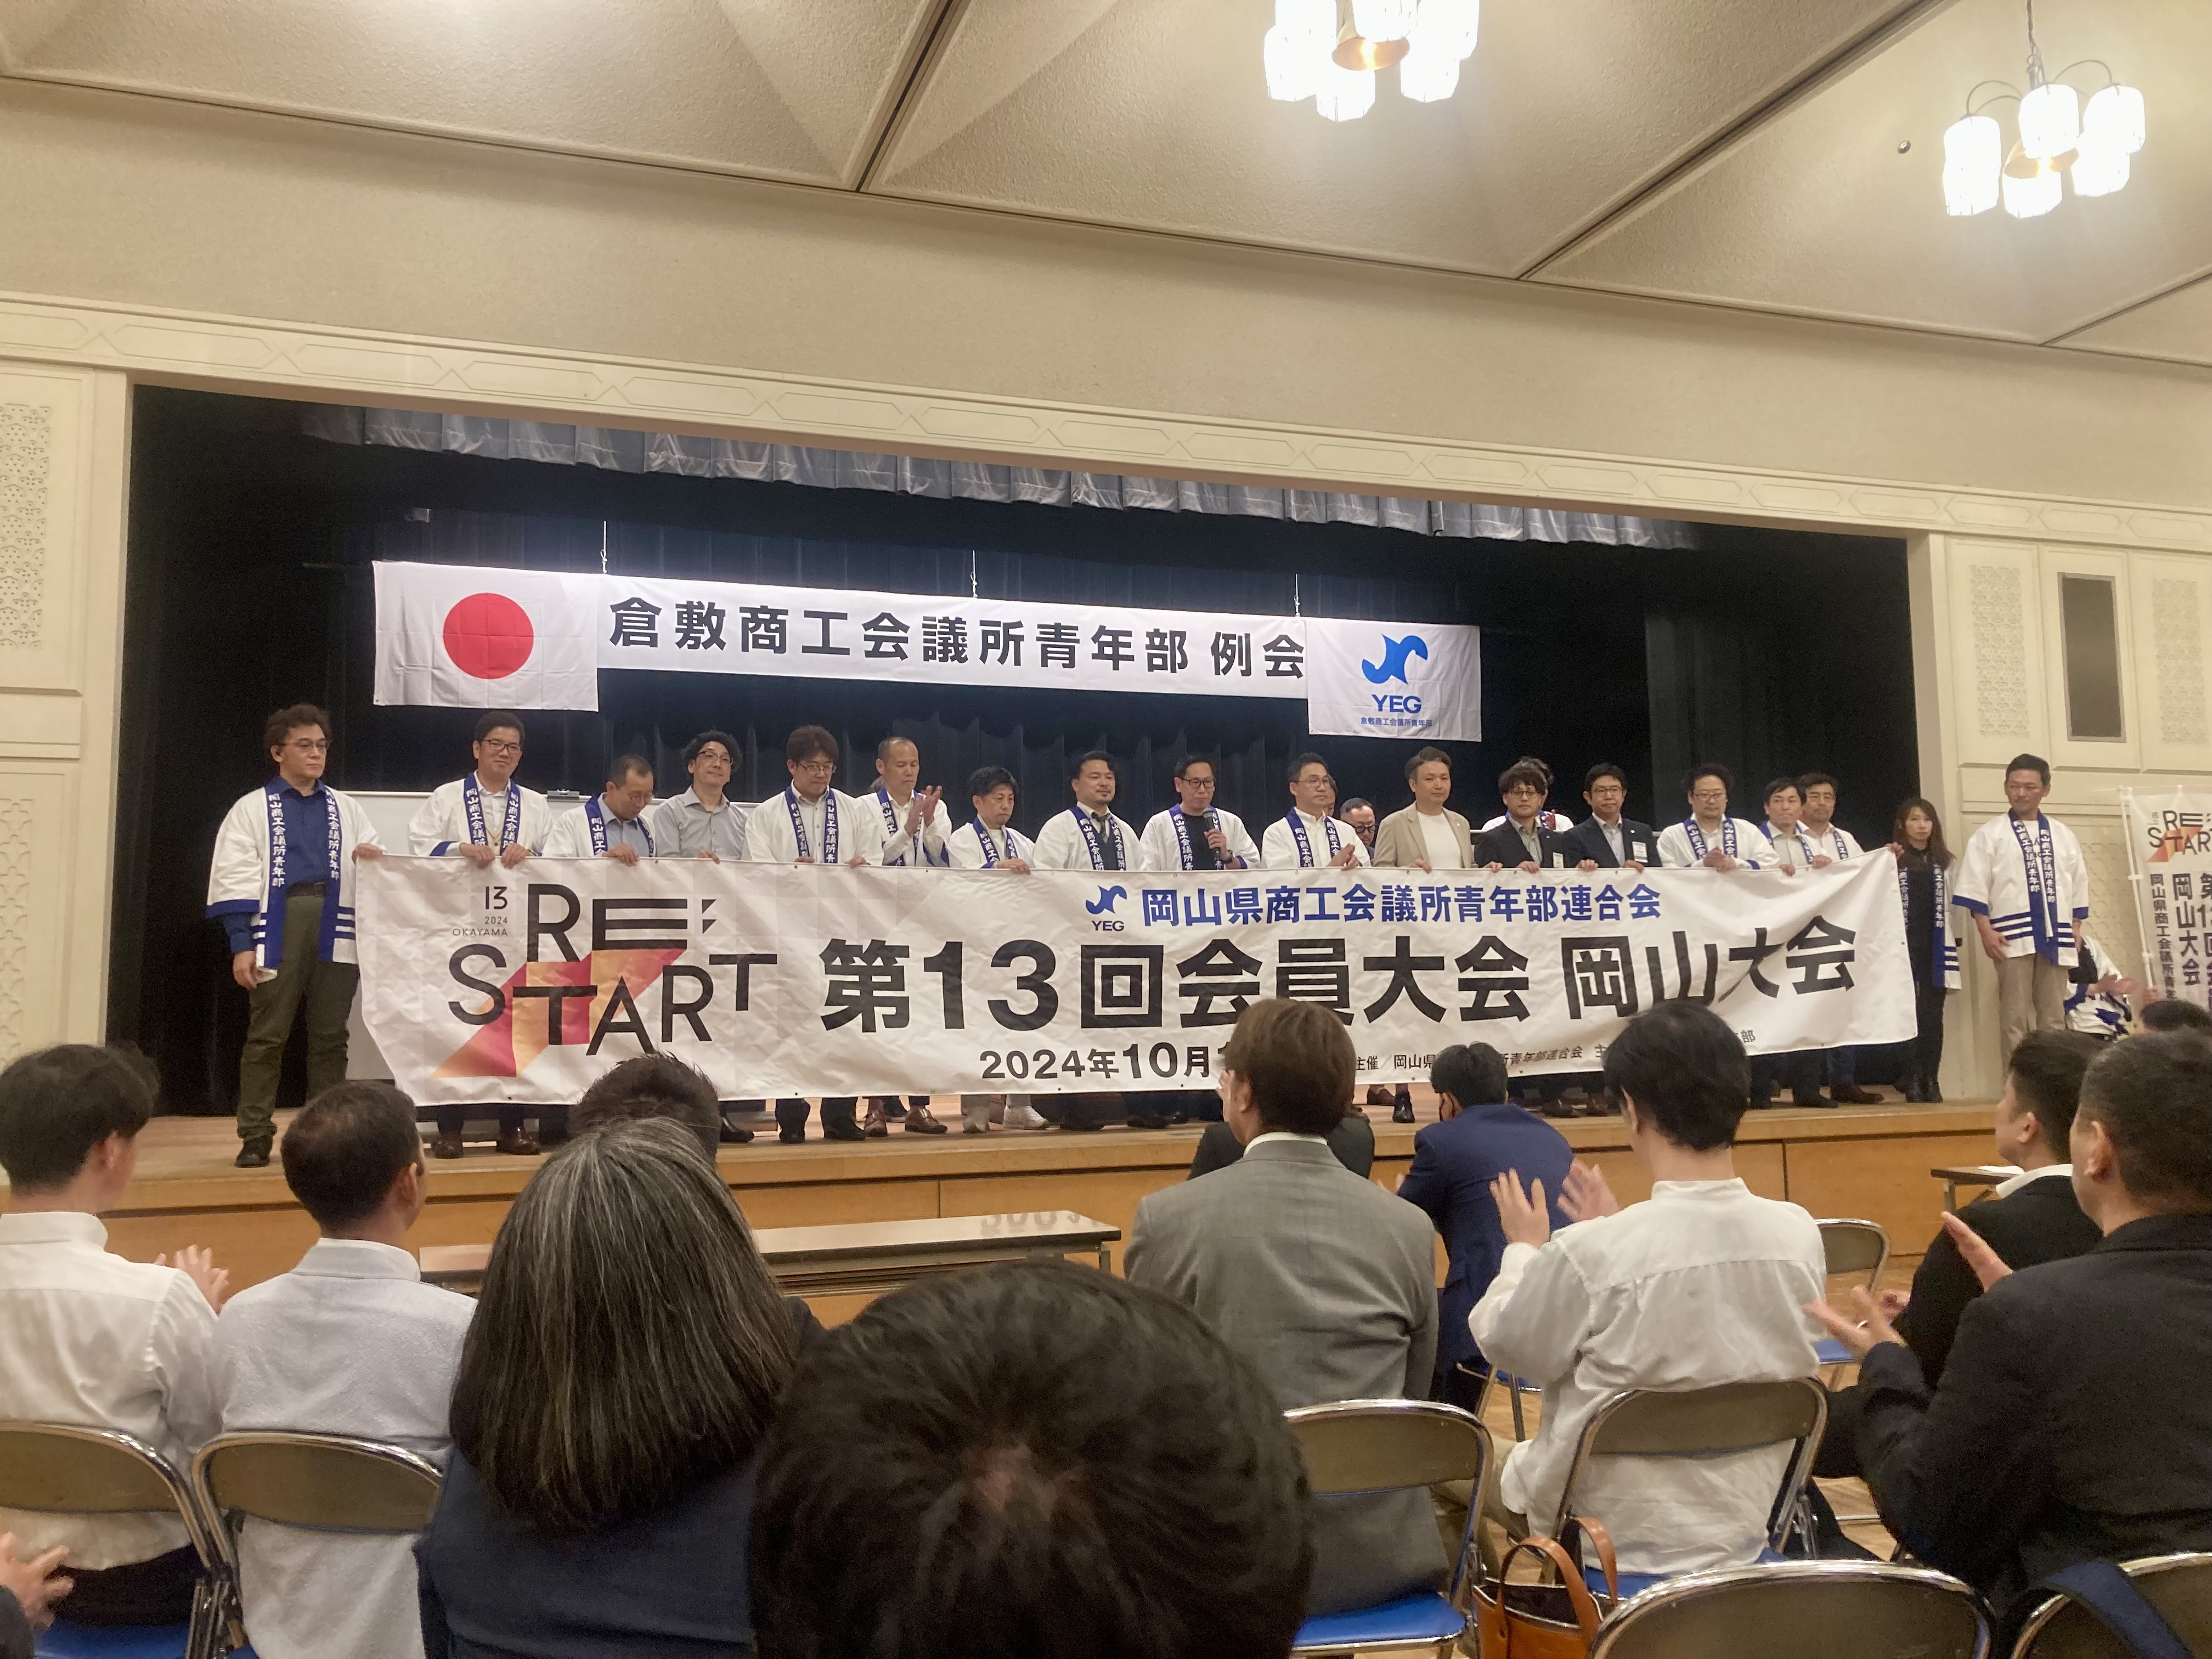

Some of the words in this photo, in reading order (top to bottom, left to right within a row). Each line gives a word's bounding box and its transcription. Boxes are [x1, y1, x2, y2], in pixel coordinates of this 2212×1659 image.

[609, 596, 1188, 673] 倉敷商工会議所青年部
[1210, 631, 1305, 680] 例会
[1372, 694, 1421, 714] YEG
[268, 793, 286, 888] 岡山商工会議所青年部
[2148, 827, 2212, 855] STAR
[486, 886, 507, 910] 13
[1142, 883, 1661, 927] 岡山県商工会議所青年部連合会
[453, 928, 507, 936] OKAYAMA
[484, 916, 507, 924] 2024
[1091, 920, 1125, 932] YEG
[2172, 873, 2201, 986] 岡山大会
[819, 936, 1530, 1034] 第13回会員大会
[1561, 915, 1857, 1019] 岡山大会
[448, 944, 777, 1056] START
